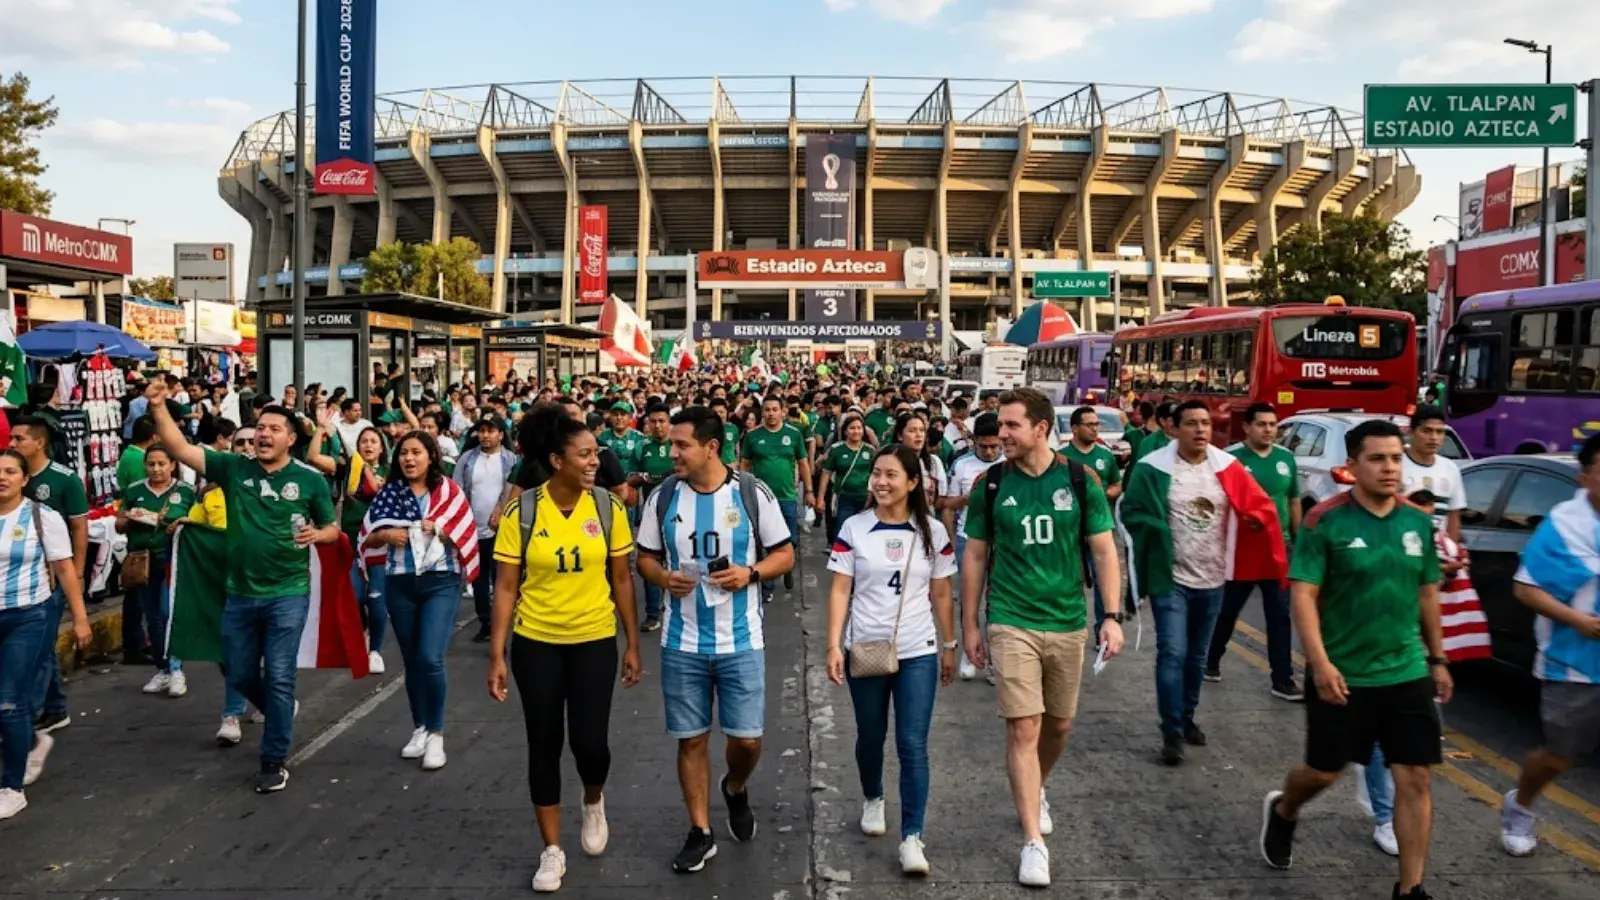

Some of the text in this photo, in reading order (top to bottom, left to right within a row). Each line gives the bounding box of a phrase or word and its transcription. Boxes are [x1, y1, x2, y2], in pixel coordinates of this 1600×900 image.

[340, 34, 352, 62] CUP
[339, 65, 352, 118] WORLD
[1405, 95, 1536, 112] AV. TLALPAN
[339, 119, 352, 150] FIFA
[1373, 120, 1541, 138] ESTADIO AZTECA
[746, 258, 887, 274] Estadio Azteca
[1500, 249, 1539, 274] CDMX
[823, 298, 838, 316] 3
[818, 325, 902, 336] AFICIONADOS
[1363, 327, 1378, 345] 5
[1020, 514, 1054, 545] 10
[688, 530, 720, 559] 10
[555, 545, 584, 574] 11
[887, 570, 902, 596] 4
